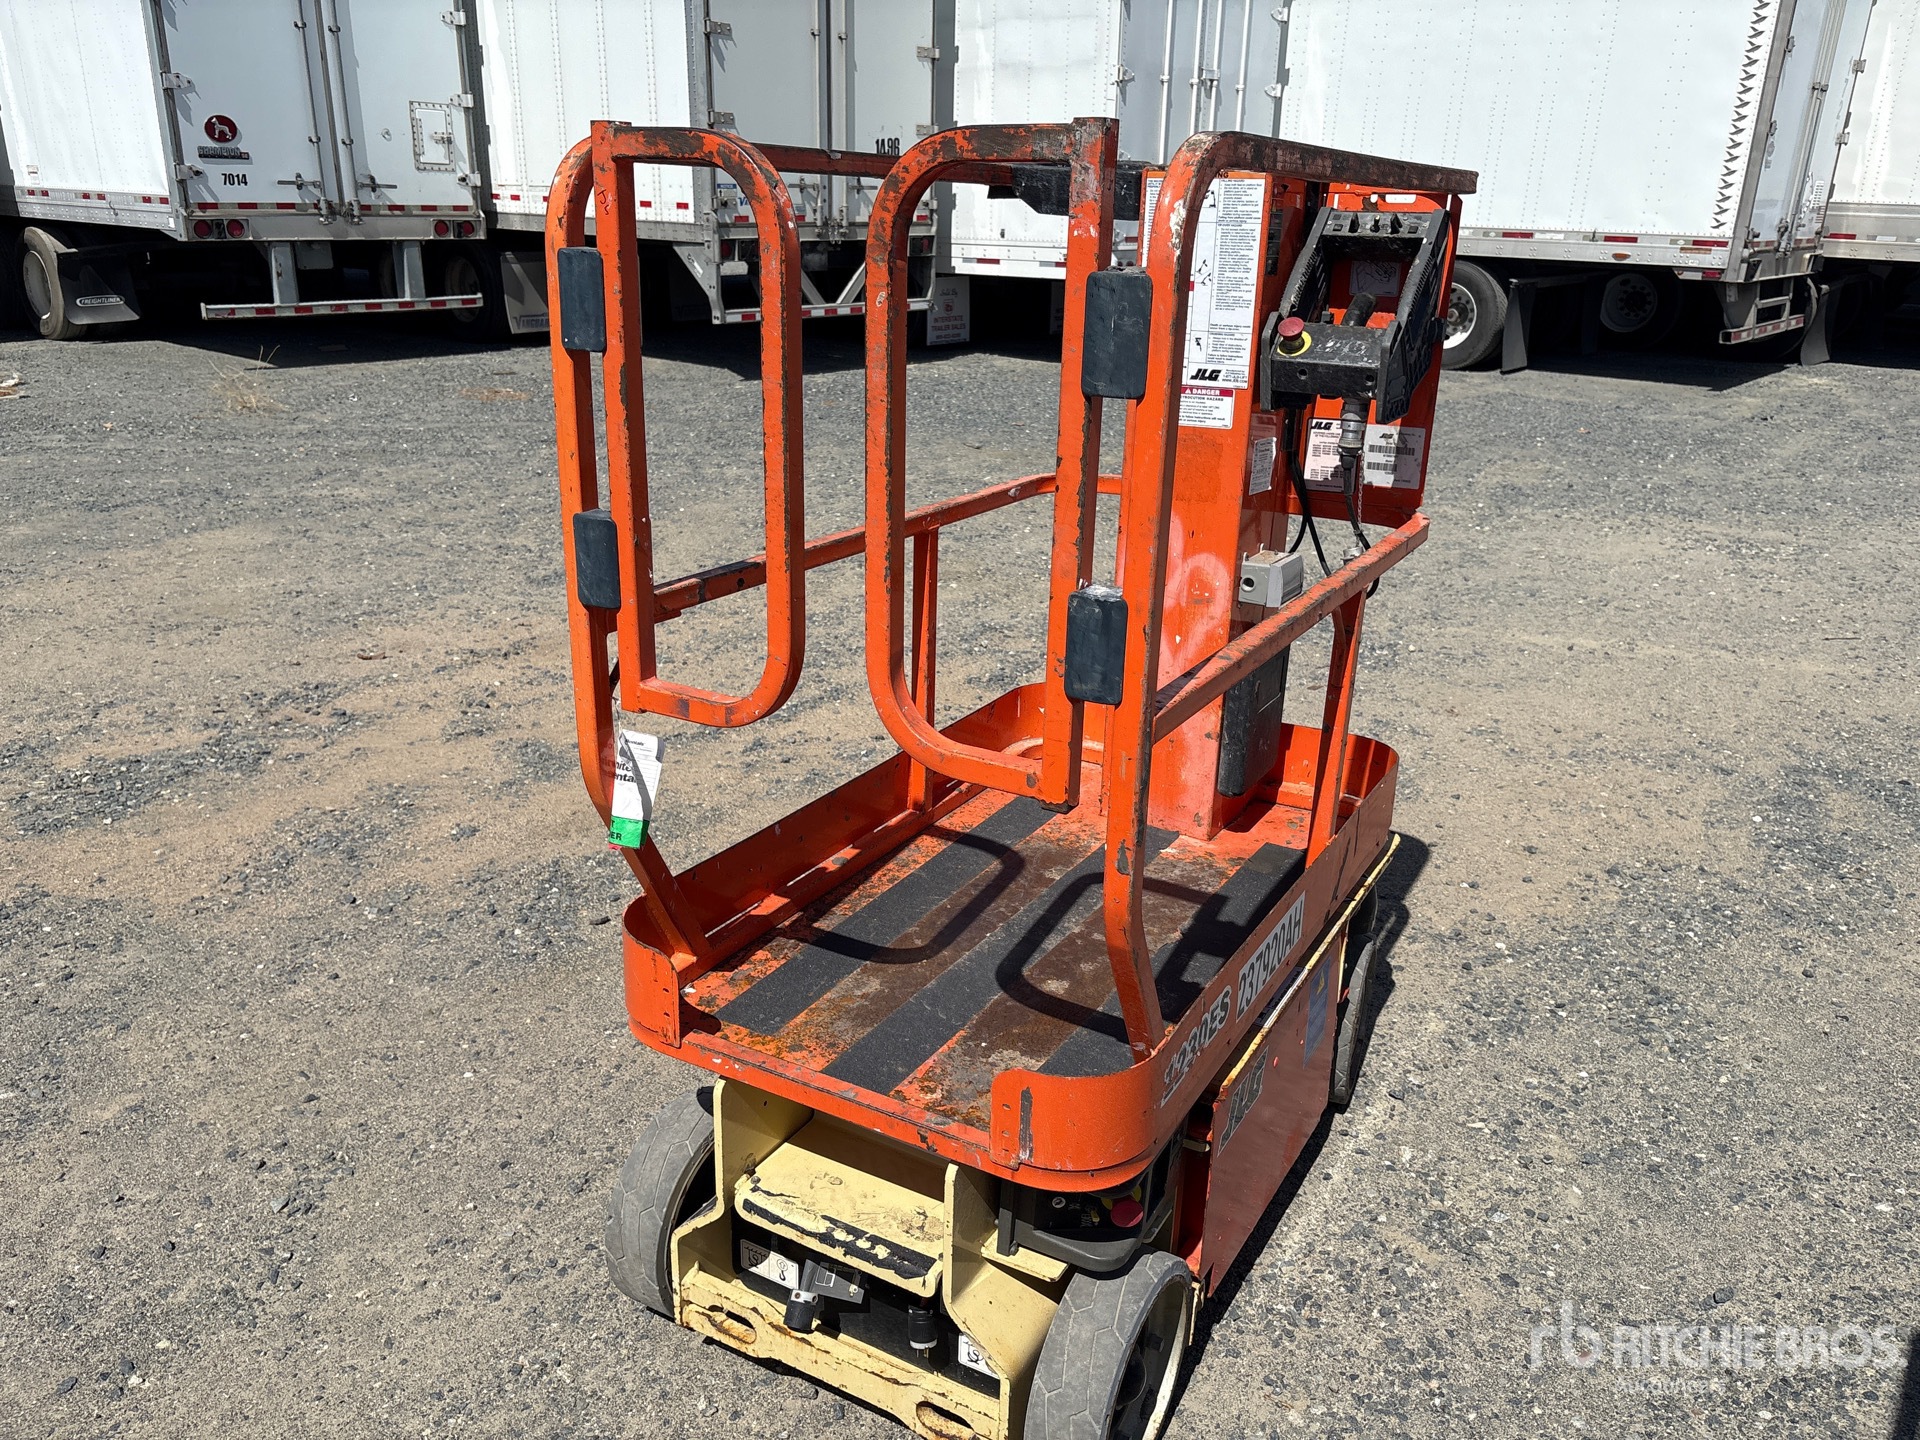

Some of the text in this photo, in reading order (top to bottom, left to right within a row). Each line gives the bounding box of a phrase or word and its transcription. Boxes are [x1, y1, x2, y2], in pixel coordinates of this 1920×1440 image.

[221, 173, 248, 186] 7014
[80, 297, 122, 305] FREIGHTLINER
[1190, 368, 1222, 382] JLG
[1192, 388, 1220, 396] DANGER
[1311, 421, 1334, 430] JLG
[1238, 903, 1301, 1016] 237920AH
[1218, 1047, 1268, 1156] JLG
